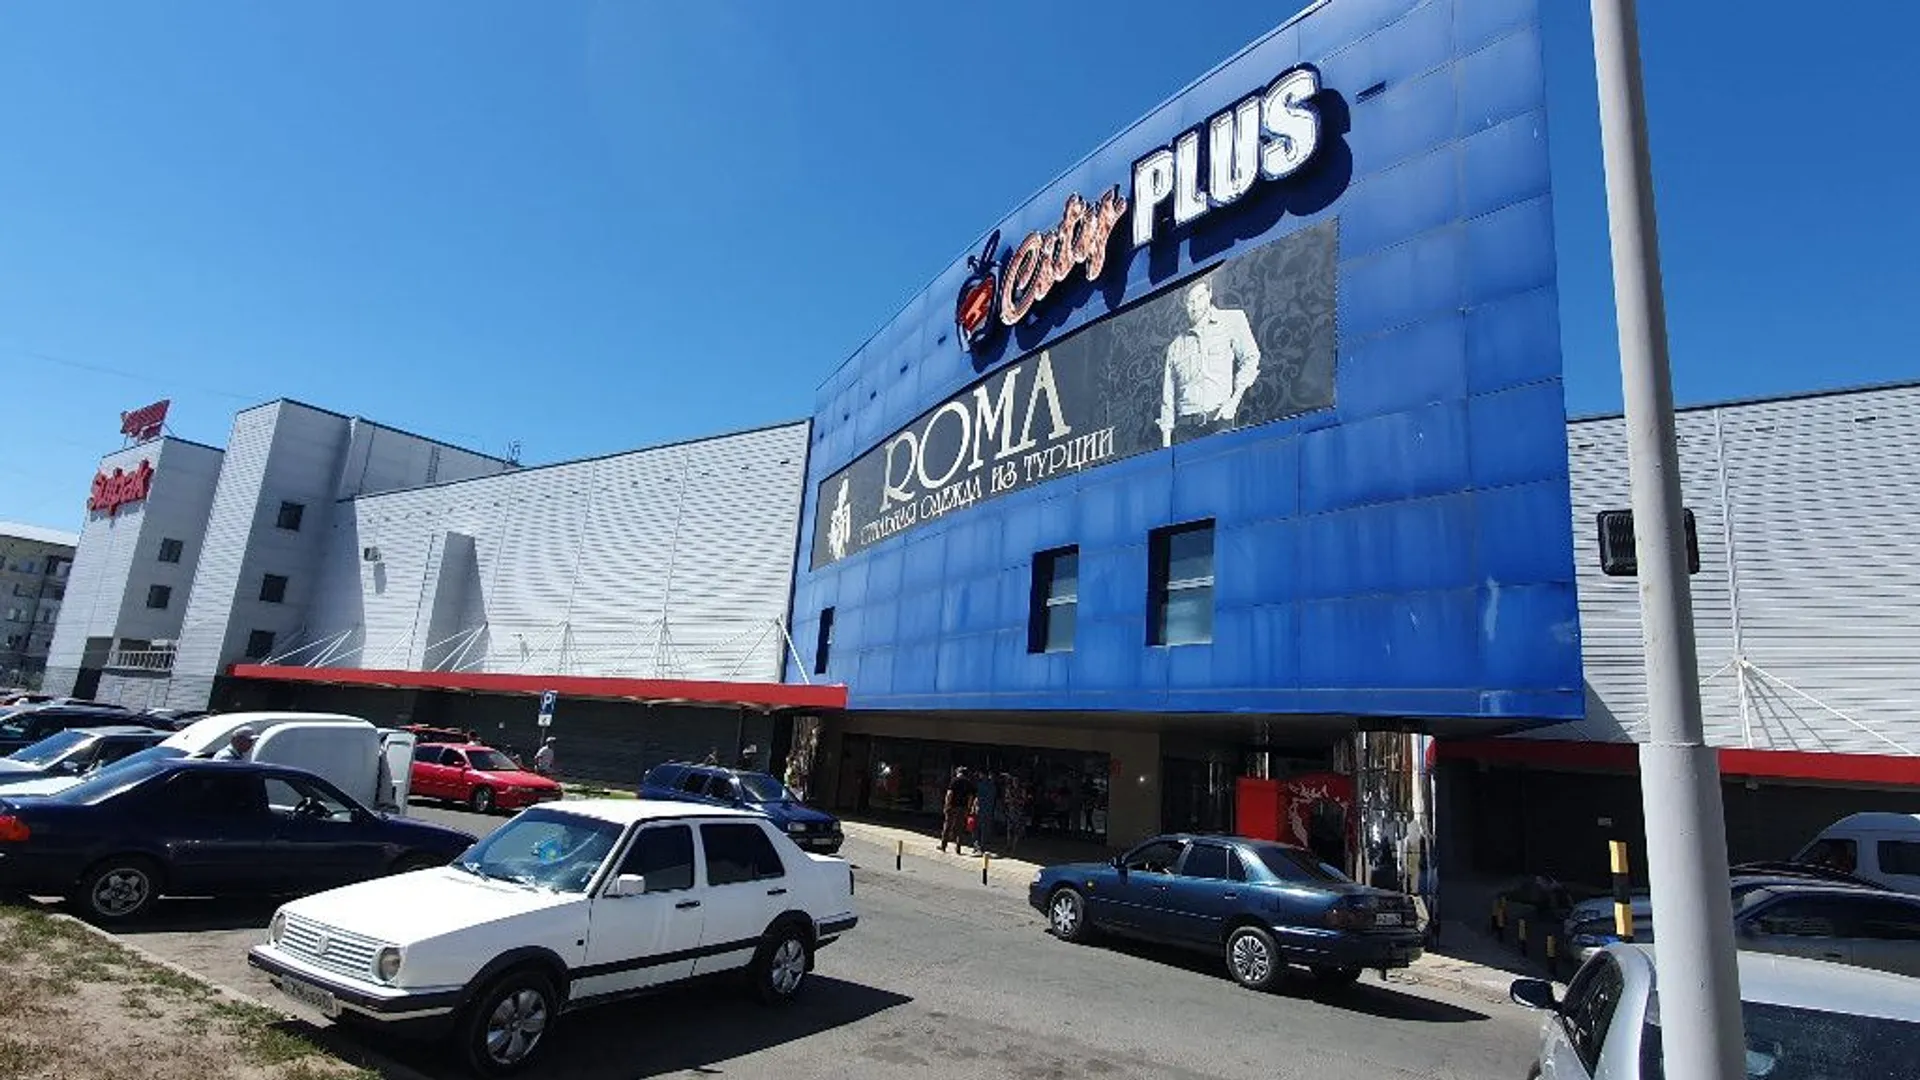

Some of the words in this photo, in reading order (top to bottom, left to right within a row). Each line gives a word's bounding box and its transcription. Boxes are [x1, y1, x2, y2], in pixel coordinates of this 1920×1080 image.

[1000, 186, 1127, 326] City
[1132, 66, 1321, 250] PLUS
[879, 350, 1071, 513] ROMA
[920, 475, 982, 519] ОДЕЖДА
[990, 461, 1018, 495] ИЗ
[1023, 426, 1116, 482] ТУРЦИИ
[542, 693, 553, 711] P
